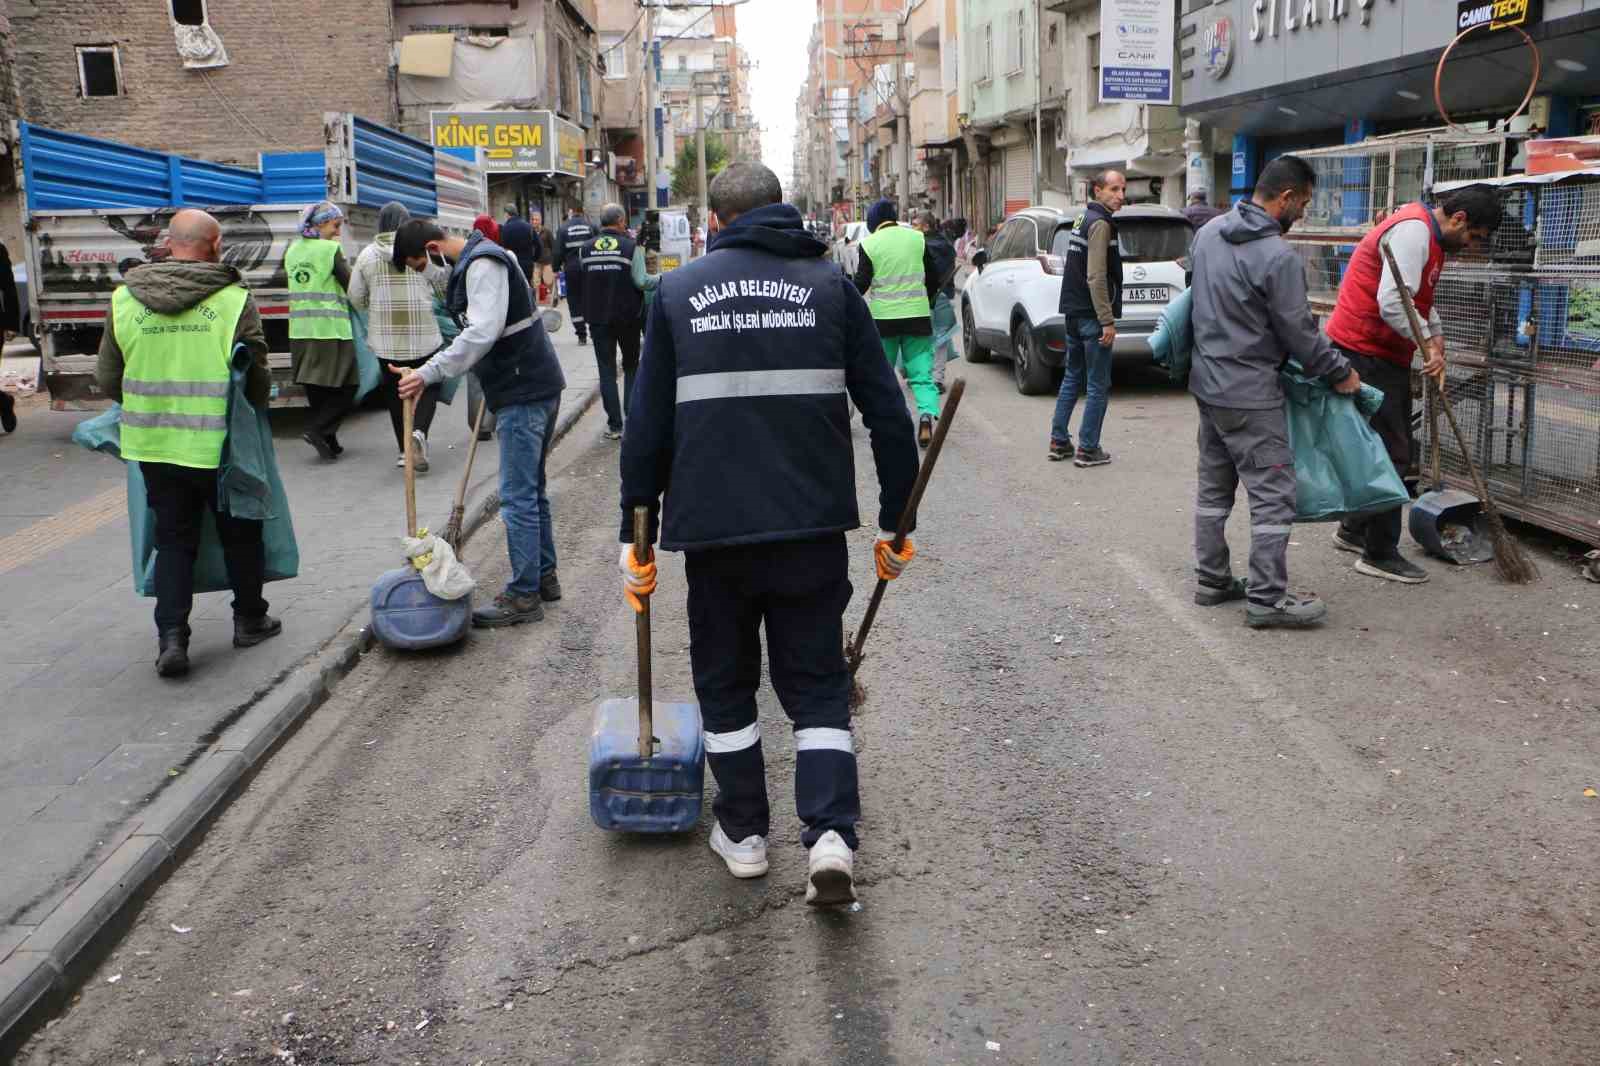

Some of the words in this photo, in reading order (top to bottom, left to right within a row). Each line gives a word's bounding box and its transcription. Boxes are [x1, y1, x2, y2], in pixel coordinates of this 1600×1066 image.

[494, 125, 541, 146] GSM
[688, 281, 739, 312] BAĞLAR
[739, 278, 813, 306] BELEDİYESİ
[1150, 288, 1166, 300] 604
[690, 310, 731, 334] TEMİZLİK
[732, 309, 760, 333] İŞLERİ
[762, 308, 816, 329] MÜDÜRLÜĞÜ
